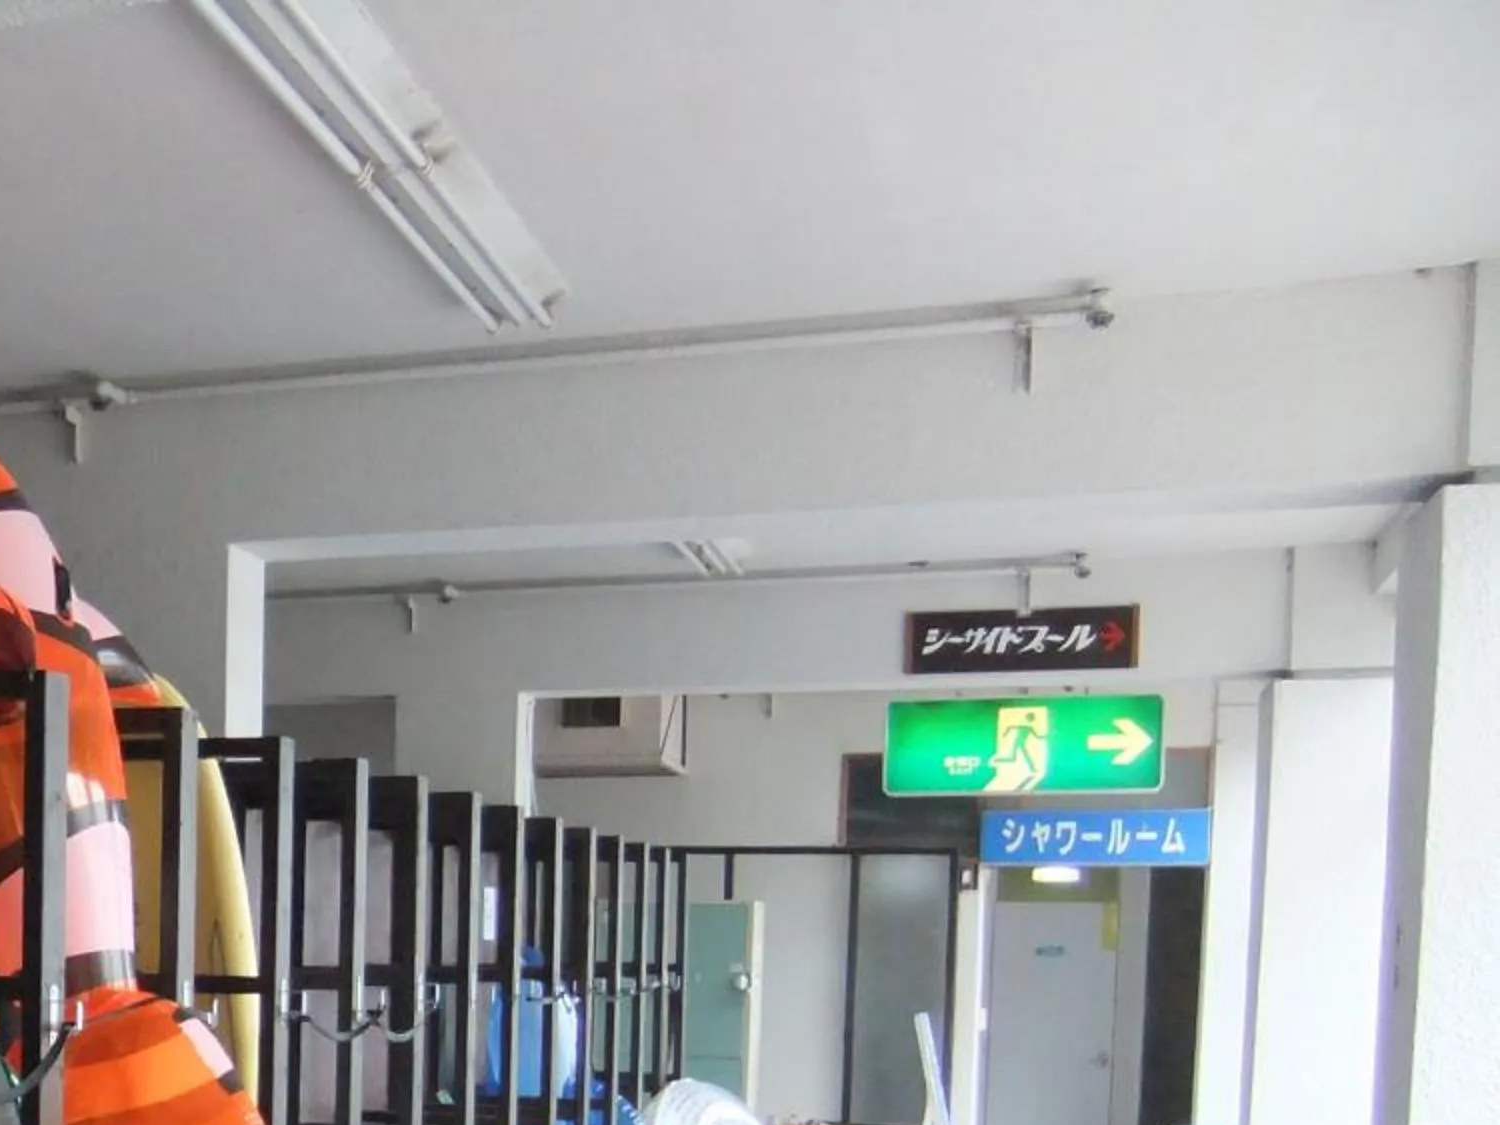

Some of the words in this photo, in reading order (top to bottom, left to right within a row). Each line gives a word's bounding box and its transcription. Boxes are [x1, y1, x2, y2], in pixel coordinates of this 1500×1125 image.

[921, 623, 1097, 656] シーサイドプール
[1002, 817, 1186, 855] シャワールーム
